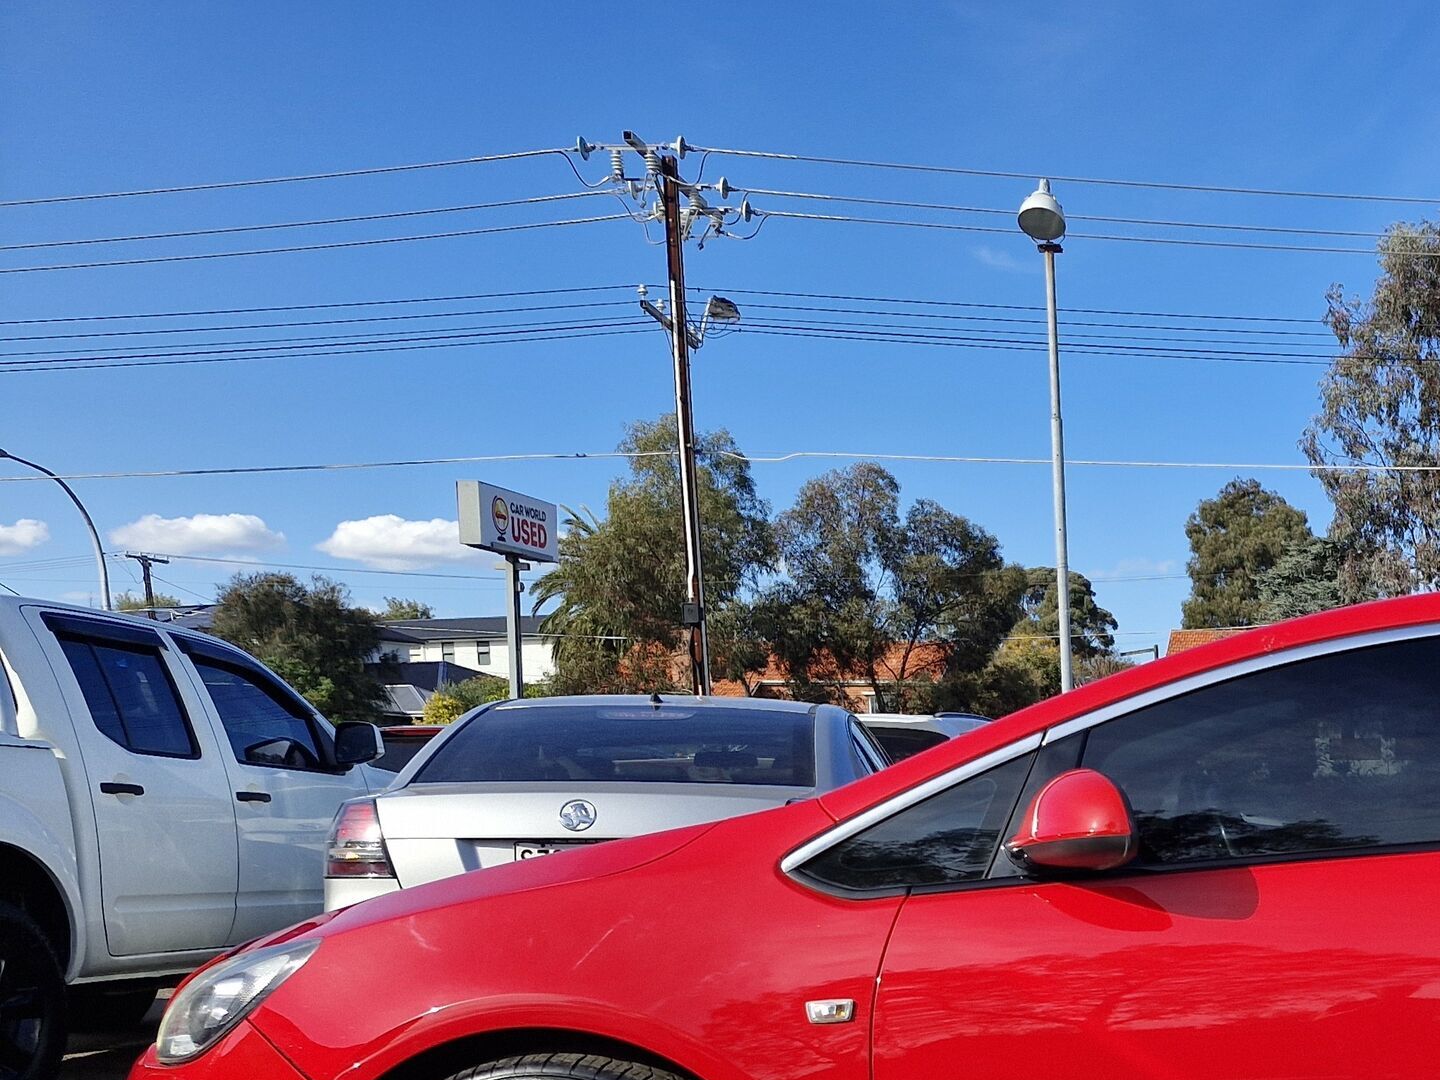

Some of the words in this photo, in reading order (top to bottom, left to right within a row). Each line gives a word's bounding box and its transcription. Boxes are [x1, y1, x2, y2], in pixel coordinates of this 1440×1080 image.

[510, 502, 523, 516] CAR
[525, 507, 547, 522] WORLD
[511, 516, 547, 549] USED
